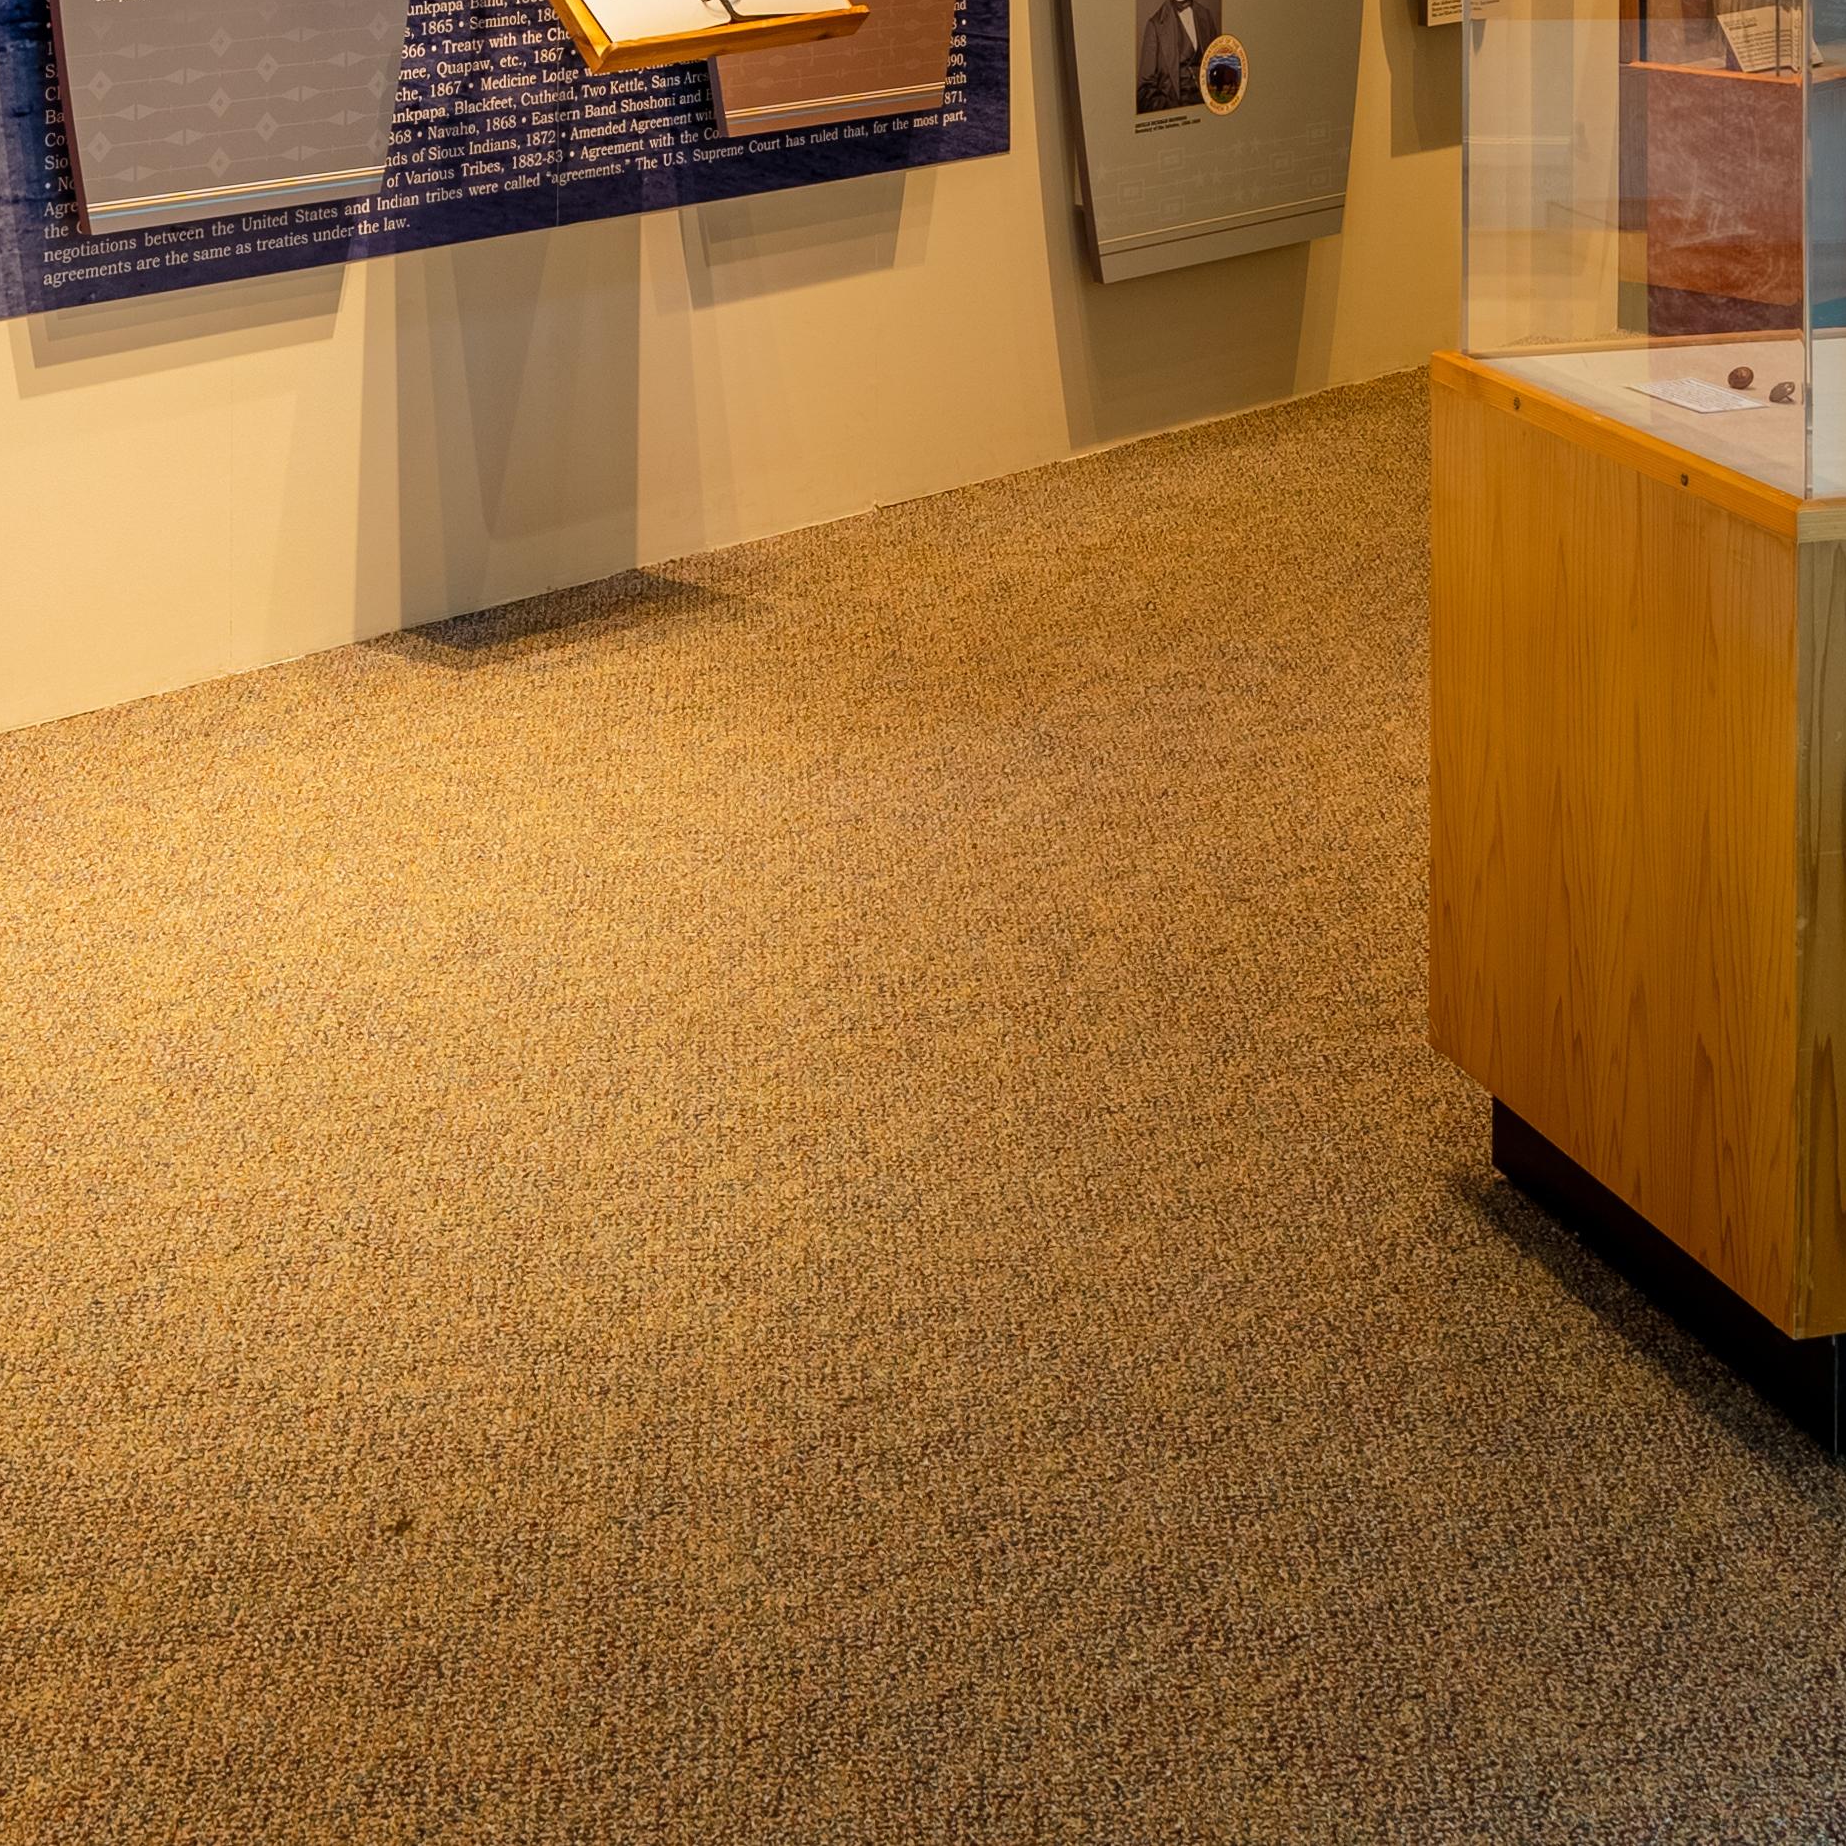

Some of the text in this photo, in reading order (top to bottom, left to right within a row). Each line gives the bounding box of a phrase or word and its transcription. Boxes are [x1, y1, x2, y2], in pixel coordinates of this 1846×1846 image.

[42, 216, 411, 289] agreements are the same as treaties under the law.
